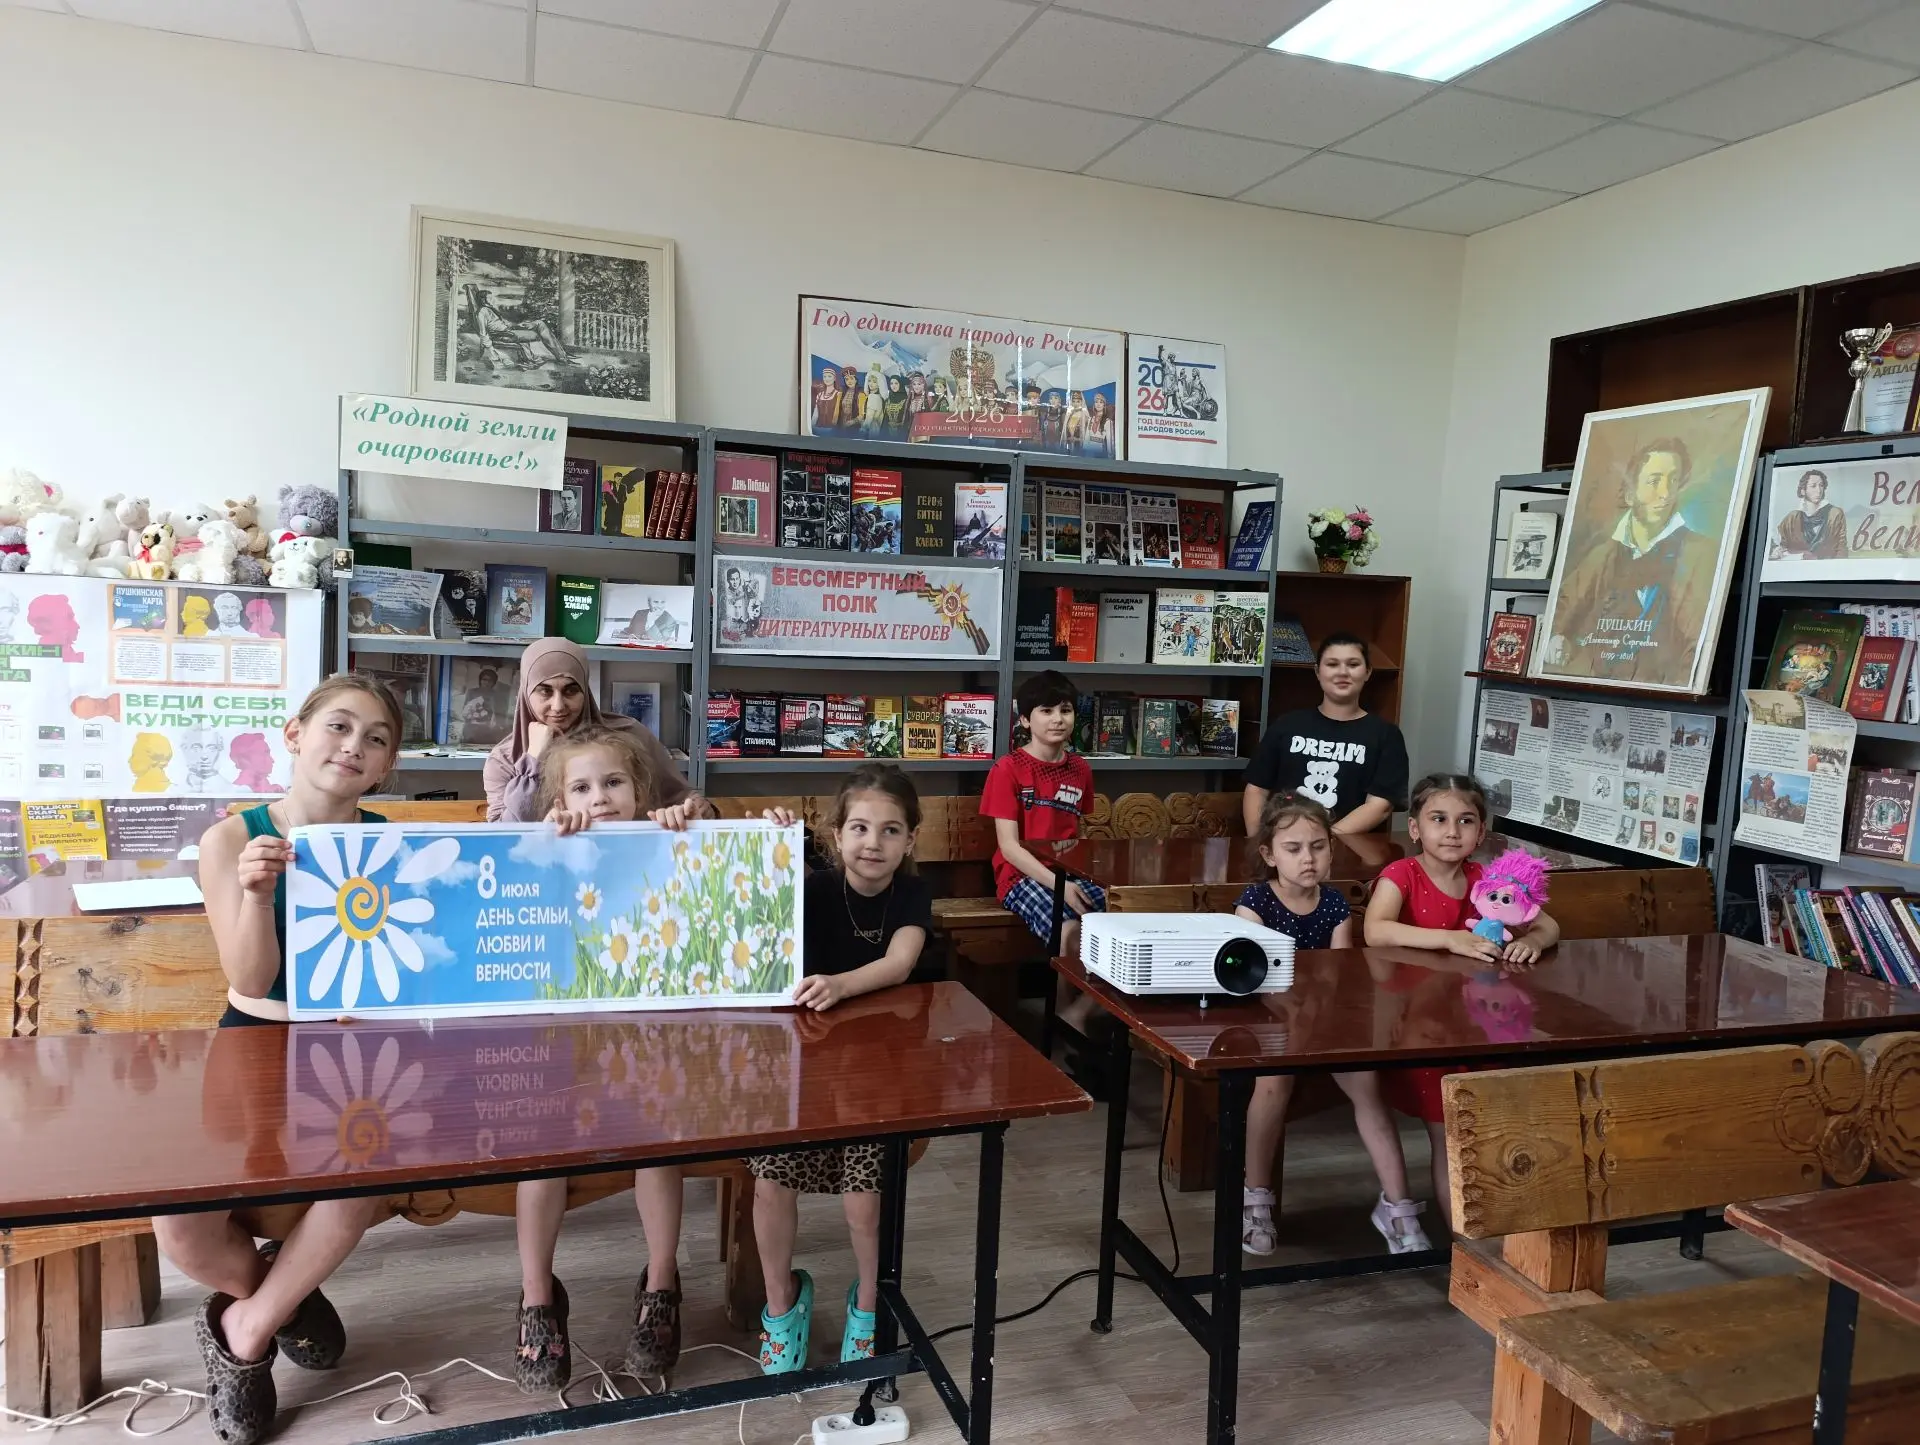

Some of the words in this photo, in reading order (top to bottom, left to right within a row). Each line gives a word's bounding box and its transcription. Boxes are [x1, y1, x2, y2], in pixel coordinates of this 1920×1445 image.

[812, 308, 851, 328] Год
[856, 313, 954, 338] единства
[959, 327, 1035, 348] народов
[1040, 333, 1107, 356] России
[1872, 362, 1917, 379] ДИПЛО
[1137, 387, 1165, 411] 26
[352, 401, 470, 433] «Родной
[478, 418, 558, 442] земли
[946, 405, 1004, 424] 2026
[1138, 426, 1174, 434] НАРОДОВ
[1175, 428, 1206, 436] РОССИИ
[1156, 419, 1193, 428] ЕДИНСТВА
[357, 438, 540, 473] очарованье!»
[732, 477, 747, 491] День
[748, 478, 770, 493] Победы
[917, 510, 942, 521] БИТВЫ
[924, 524, 934, 534] ЗА
[915, 536, 944, 548] КАВКАЗ
[771, 566, 926, 592] БЕССМЕРТНЫЙ
[116, 587, 164, 597] ПУШКИНСКАЯ
[563, 594, 592, 605] БОЖИЙ
[142, 596, 164, 606] КАРТА
[822, 594, 878, 614] ПОЛК
[757, 618, 890, 640] ЛИТЕРАТУРНЫХ
[892, 624, 952, 642] ГЕРОЕВ
[1596, 618, 1653, 632] ПУШКИН
[1581, 633, 1620, 648] Александр
[126, 694, 204, 711] ВЕДИ
[213, 696, 287, 710] СЕБЯ
[126, 712, 287, 729] КУЛЬТУРНО
[906, 711, 940, 722] СУВОРОВ
[908, 728, 936, 738] МАРШАЛ
[908, 738, 936, 750] ПОБЕДЫ
[1290, 736, 1366, 764] DREAM
[106, 805, 128, 813] Где
[129, 805, 168, 814] купить
[477, 854, 497, 900] 8
[476, 908, 514, 930] ДЕНЬ
[518, 906, 572, 927] СЕМЬИ,
[476, 936, 531, 954] ЛЮБВИ
[535, 935, 546, 952] И
[476, 962, 550, 982] ВЕРНОСТИ
